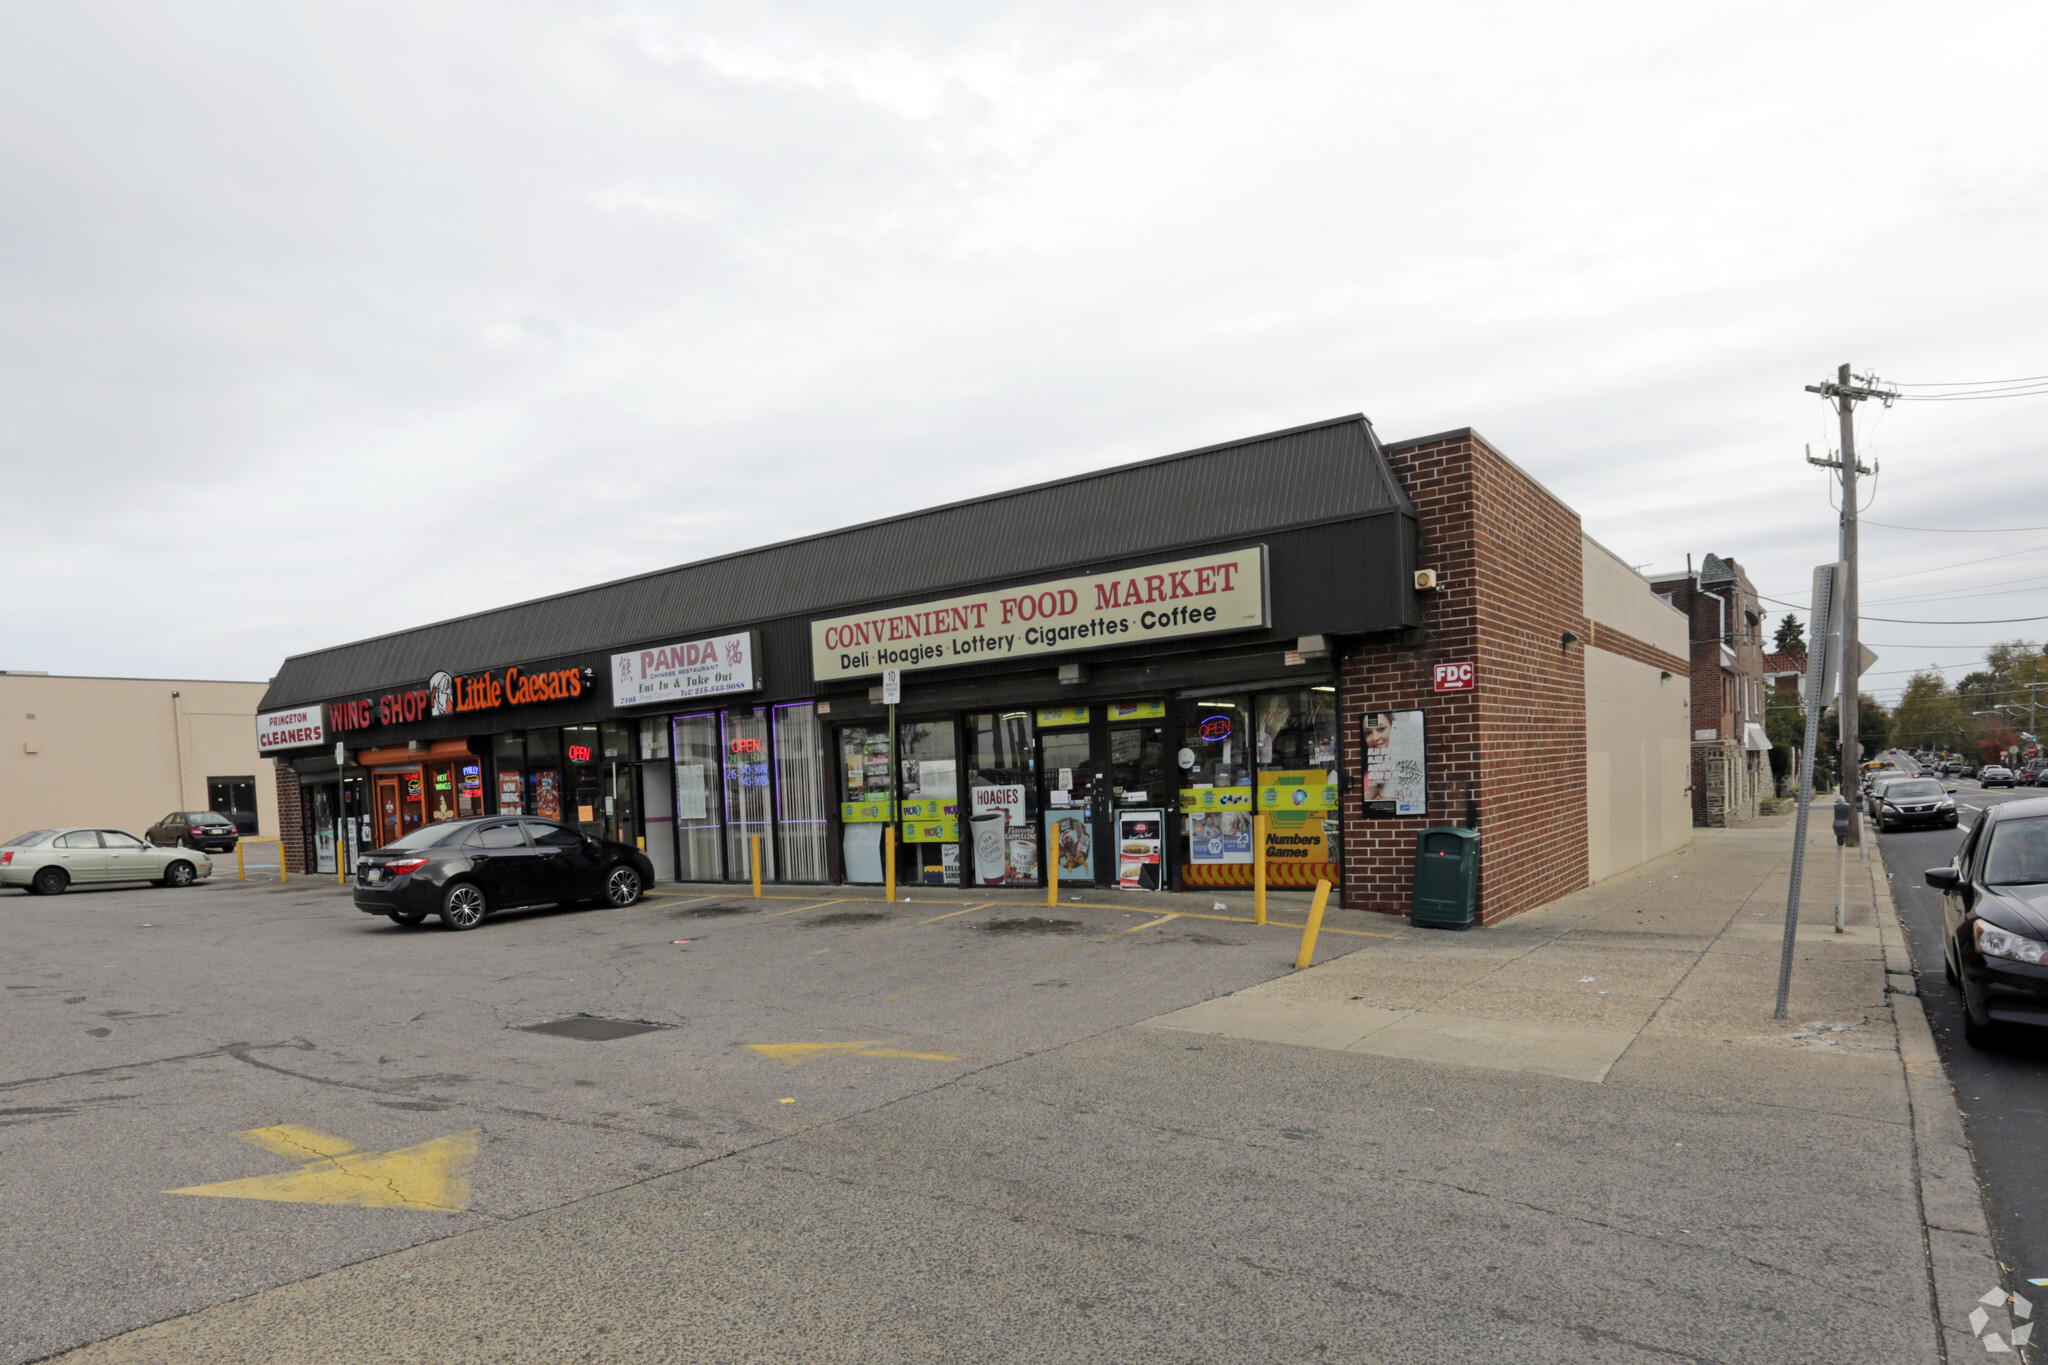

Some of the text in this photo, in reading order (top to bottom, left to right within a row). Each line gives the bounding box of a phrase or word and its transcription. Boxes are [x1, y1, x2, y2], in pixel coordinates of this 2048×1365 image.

[824, 562, 1238, 651] CONVENIENT FOOD MARKET
[840, 605, 1217, 670] Deli Hoagies Lottery Cigarettes Coffee
[640, 640, 718, 680] PANDA
[650, 664, 719, 680] CHINESE RESTAURANT
[888, 671, 895, 681] 10
[1436, 664, 1472, 682] FDC
[454, 667, 582, 712] Little Caesars
[638, 671, 733, 694] Eat In & Take Out
[329, 689, 427, 732] WING SHOP
[269, 712, 307, 727] PRINCETON
[1199, 719, 1231, 738] OPEN
[260, 726, 322, 747] CLEANERS
[569, 745, 591, 760] OPEN
[732, 739, 762, 752] OPEN
[437, 773, 447, 782] HOT
[435, 782, 451, 791] WINGS
[503, 782, 516, 792] NOW
[501, 792, 520, 803] HIRING
[977, 789, 1018, 805] HOAGIES
[1007, 825, 1035, 834] Flavored
[1210, 841, 1220, 851] 19
[1237, 833, 1249, 844] 23
[1266, 833, 1321, 845] Numbers
[1266, 846, 1309, 858] Games
